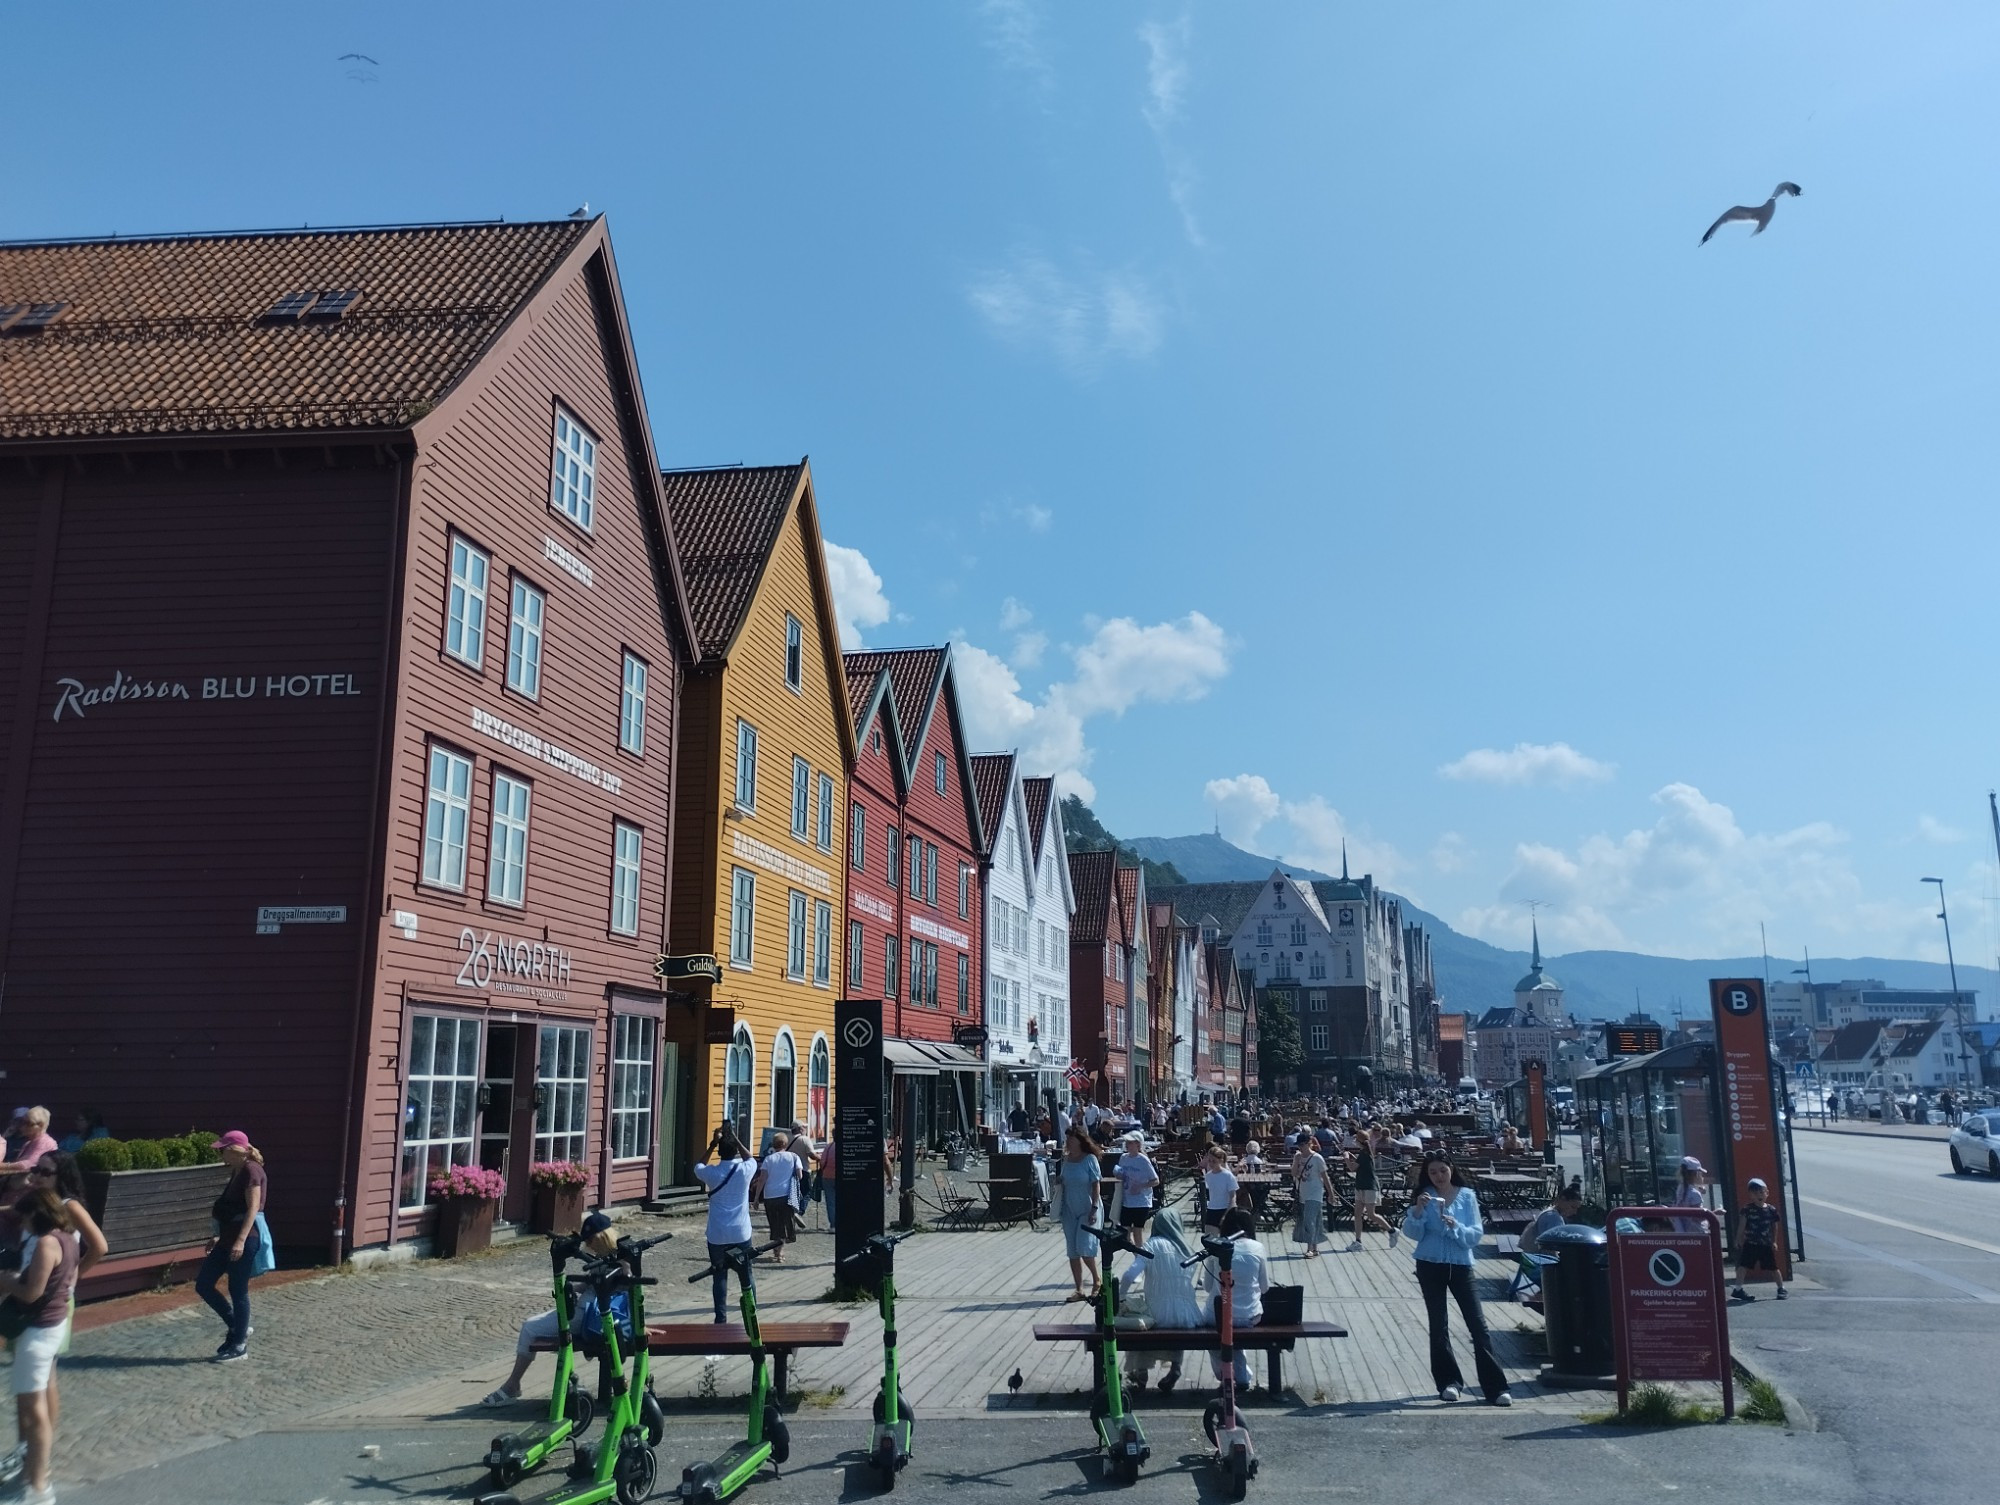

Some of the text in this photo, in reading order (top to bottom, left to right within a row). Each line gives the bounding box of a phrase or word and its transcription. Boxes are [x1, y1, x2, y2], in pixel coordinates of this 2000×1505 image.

[53, 670, 361, 723] Radisson BLU HOTEL
[471, 706, 623, 795] BRYGGEN SHIPPING INT
[263, 908, 340, 922] Dreggsallmenningen
[456, 928, 571, 988] 26 NORTH
[495, 982, 529, 995] RESTAURANT
[1731, 991, 1748, 1010] B
[1630, 1289, 1707, 1297] PARKERING FORBUDT
